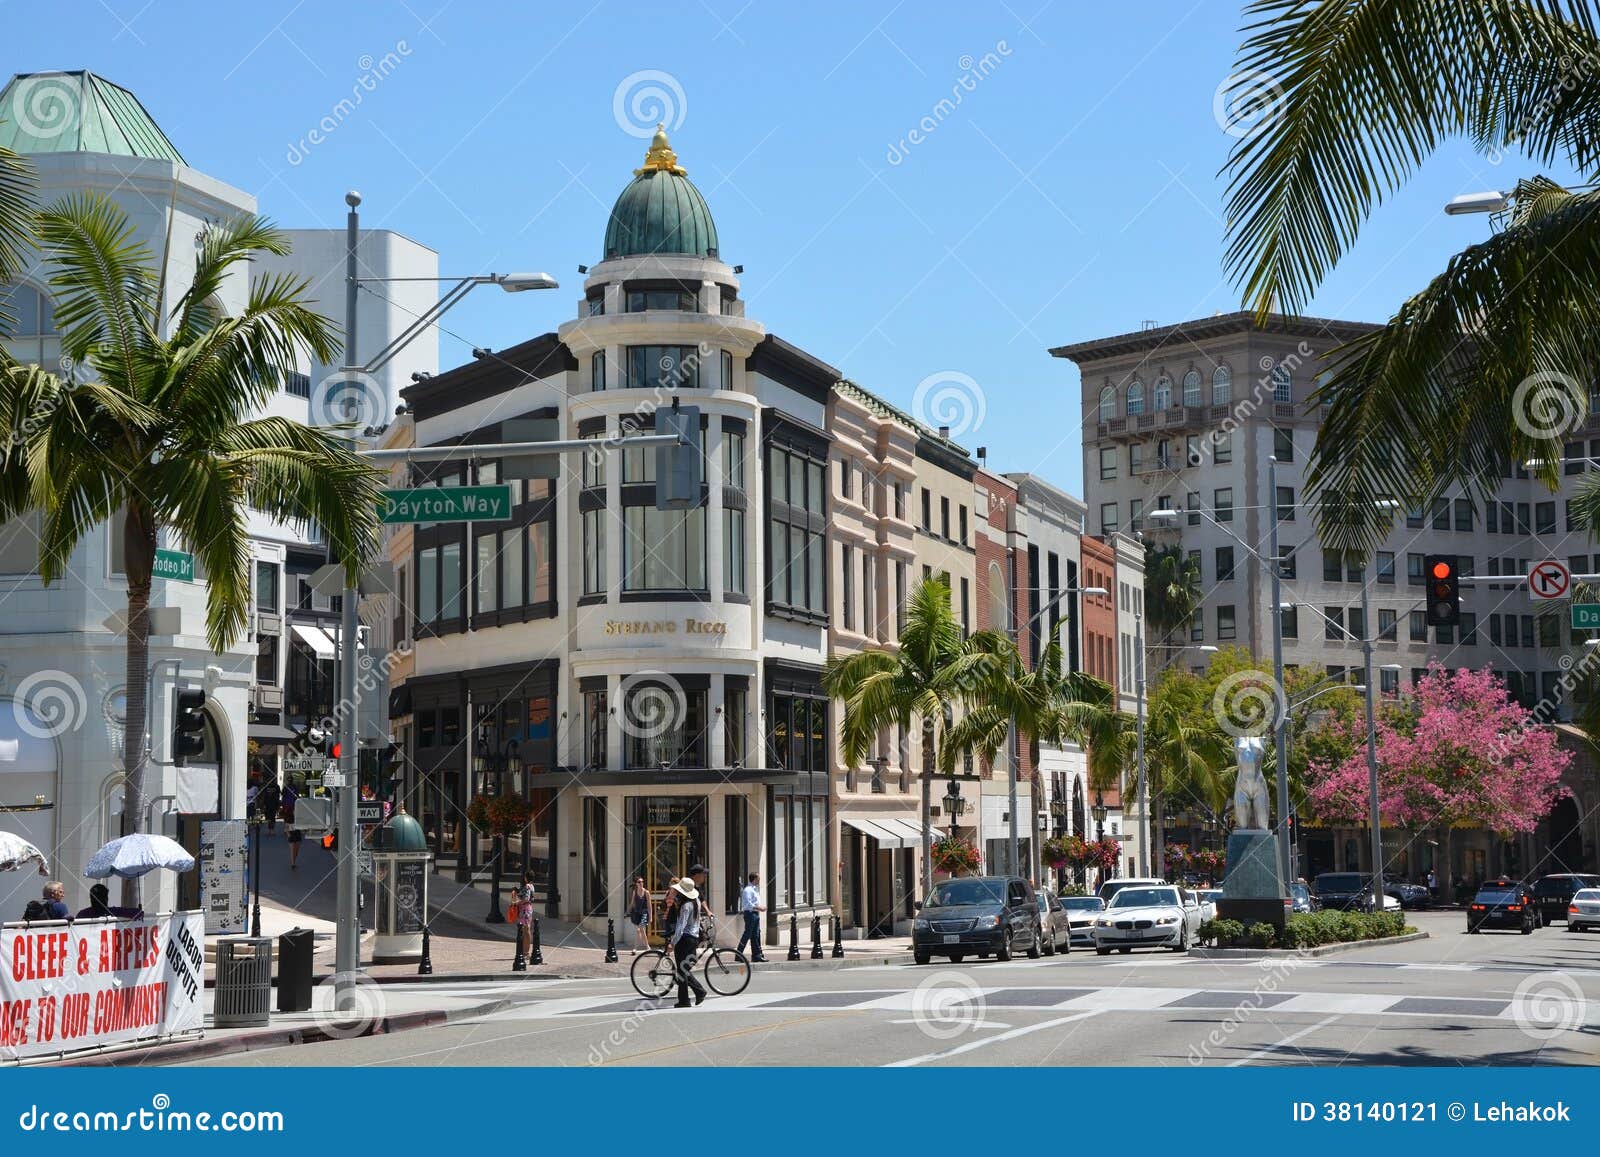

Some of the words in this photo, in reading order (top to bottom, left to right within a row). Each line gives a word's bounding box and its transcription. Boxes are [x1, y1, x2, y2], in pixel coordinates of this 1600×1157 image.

[385, 498, 455, 519] Dayton
[462, 495, 501, 517] Way
[153, 555, 178, 573] Rodeo
[181, 559, 191, 576] Dr
[685, 618, 728, 634] RICCI
[284, 760, 313, 770] DAYTON
[359, 808, 378, 819] WAY
[12, 932, 69, 983] CLEEF
[77, 937, 90, 977] &
[98, 924, 160, 974] ARPELS
[177, 921, 203, 974] LABOR
[166, 938, 199, 1004] DISPUTE
[0, 998, 32, 1048] AGE
[36, 996, 57, 1043] TO
[61, 992, 90, 1041] OUR
[93, 981, 169, 1036] COMMUNITY
